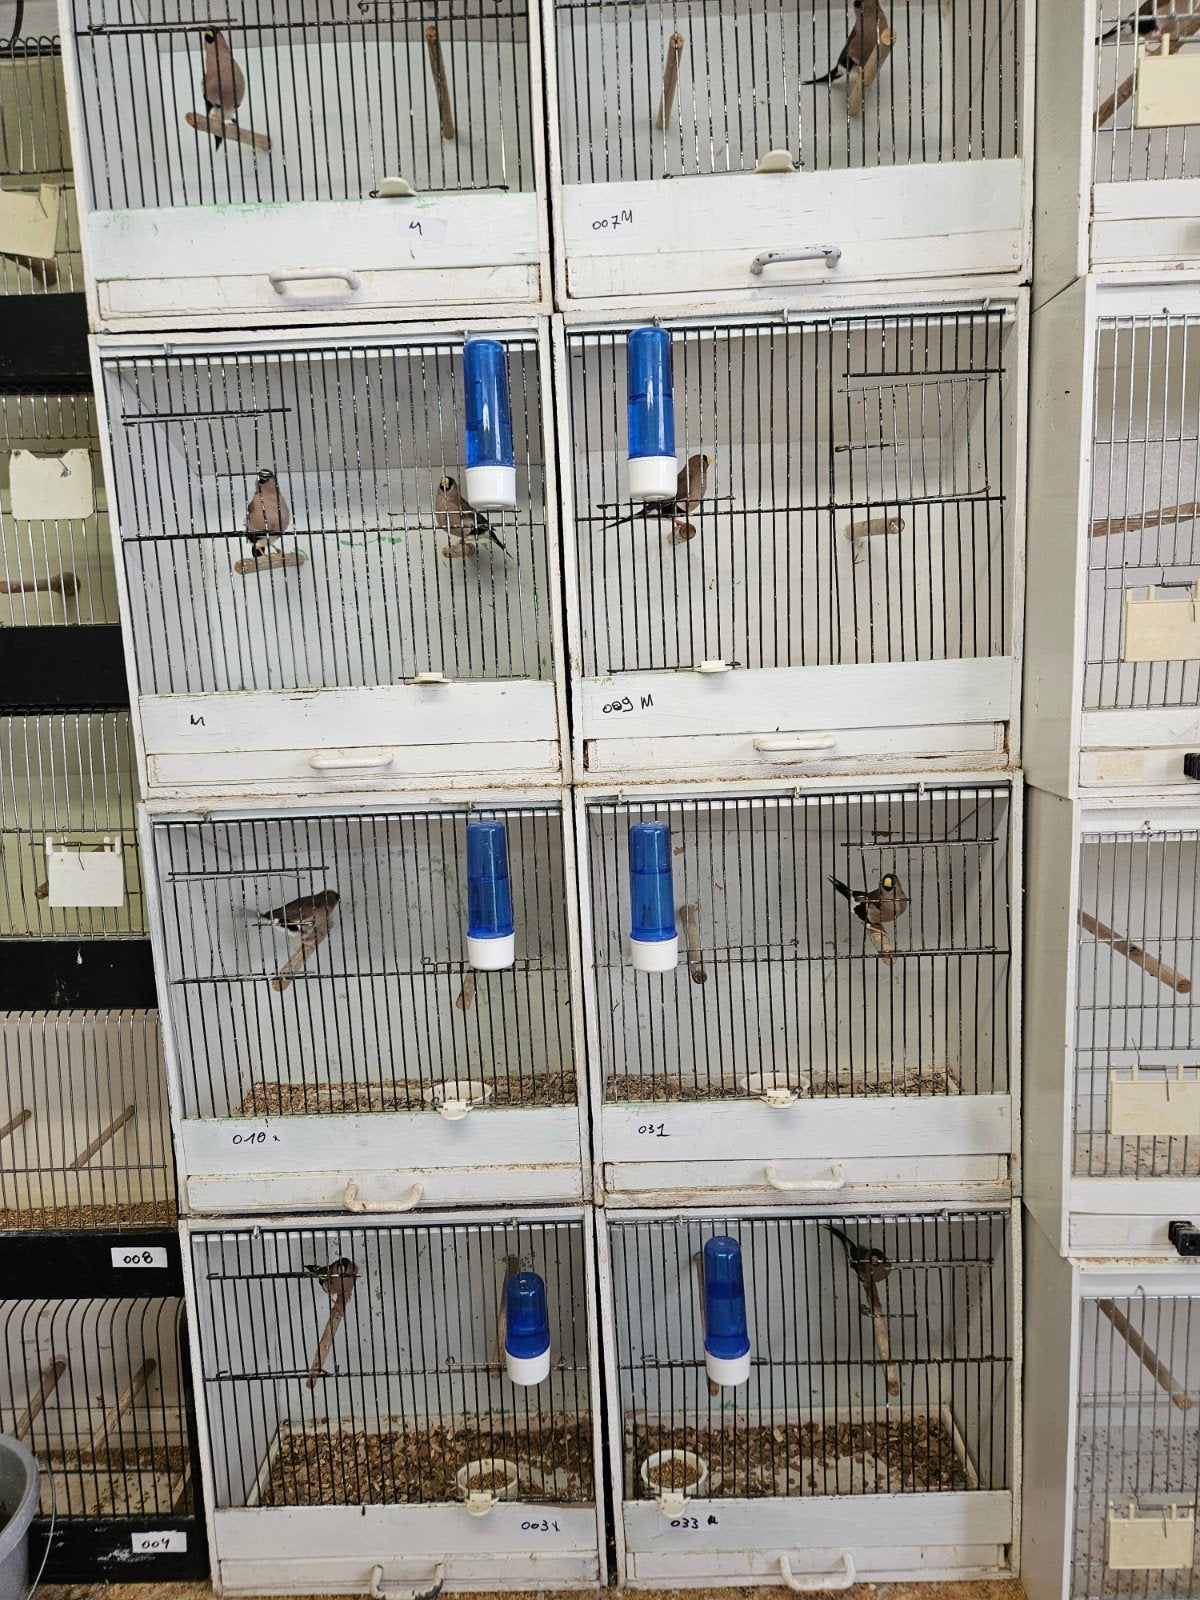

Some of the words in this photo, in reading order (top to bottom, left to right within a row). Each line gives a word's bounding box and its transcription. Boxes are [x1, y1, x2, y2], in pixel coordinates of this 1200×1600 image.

[640, 693, 654, 710] M
[638, 1123, 672, 1137] 031
[123, 1250, 153, 1264] 008
[670, 1517, 699, 1530] 033
[141, 1537, 170, 1550] 004
